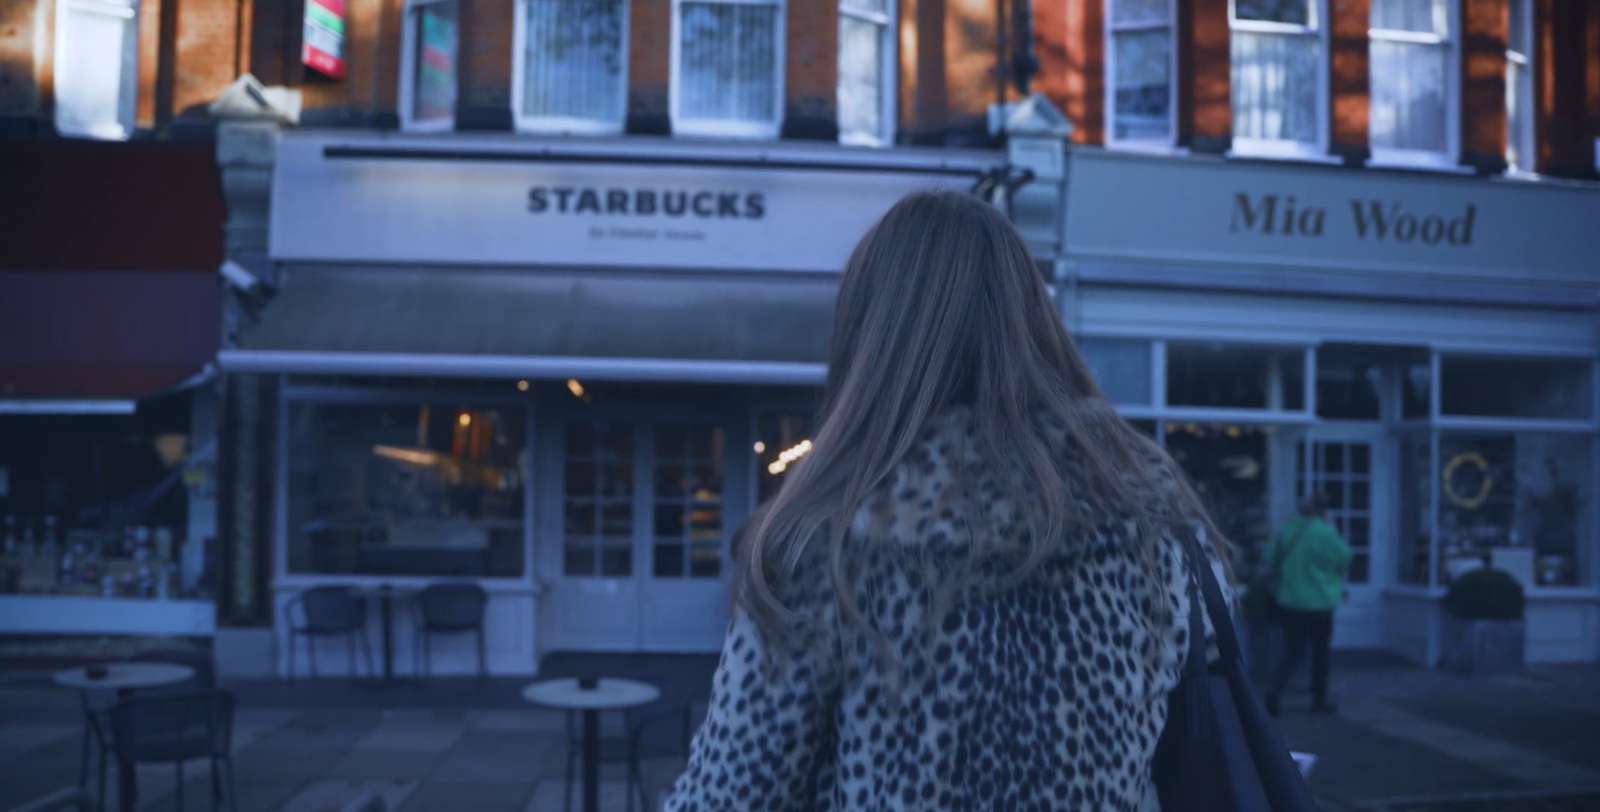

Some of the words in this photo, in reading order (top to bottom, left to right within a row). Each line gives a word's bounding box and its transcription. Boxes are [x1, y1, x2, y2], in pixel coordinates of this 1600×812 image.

[527, 186, 766, 220] STARBUCKS
[1229, 191, 1327, 237] Mia
[1349, 198, 1477, 246] Wood
